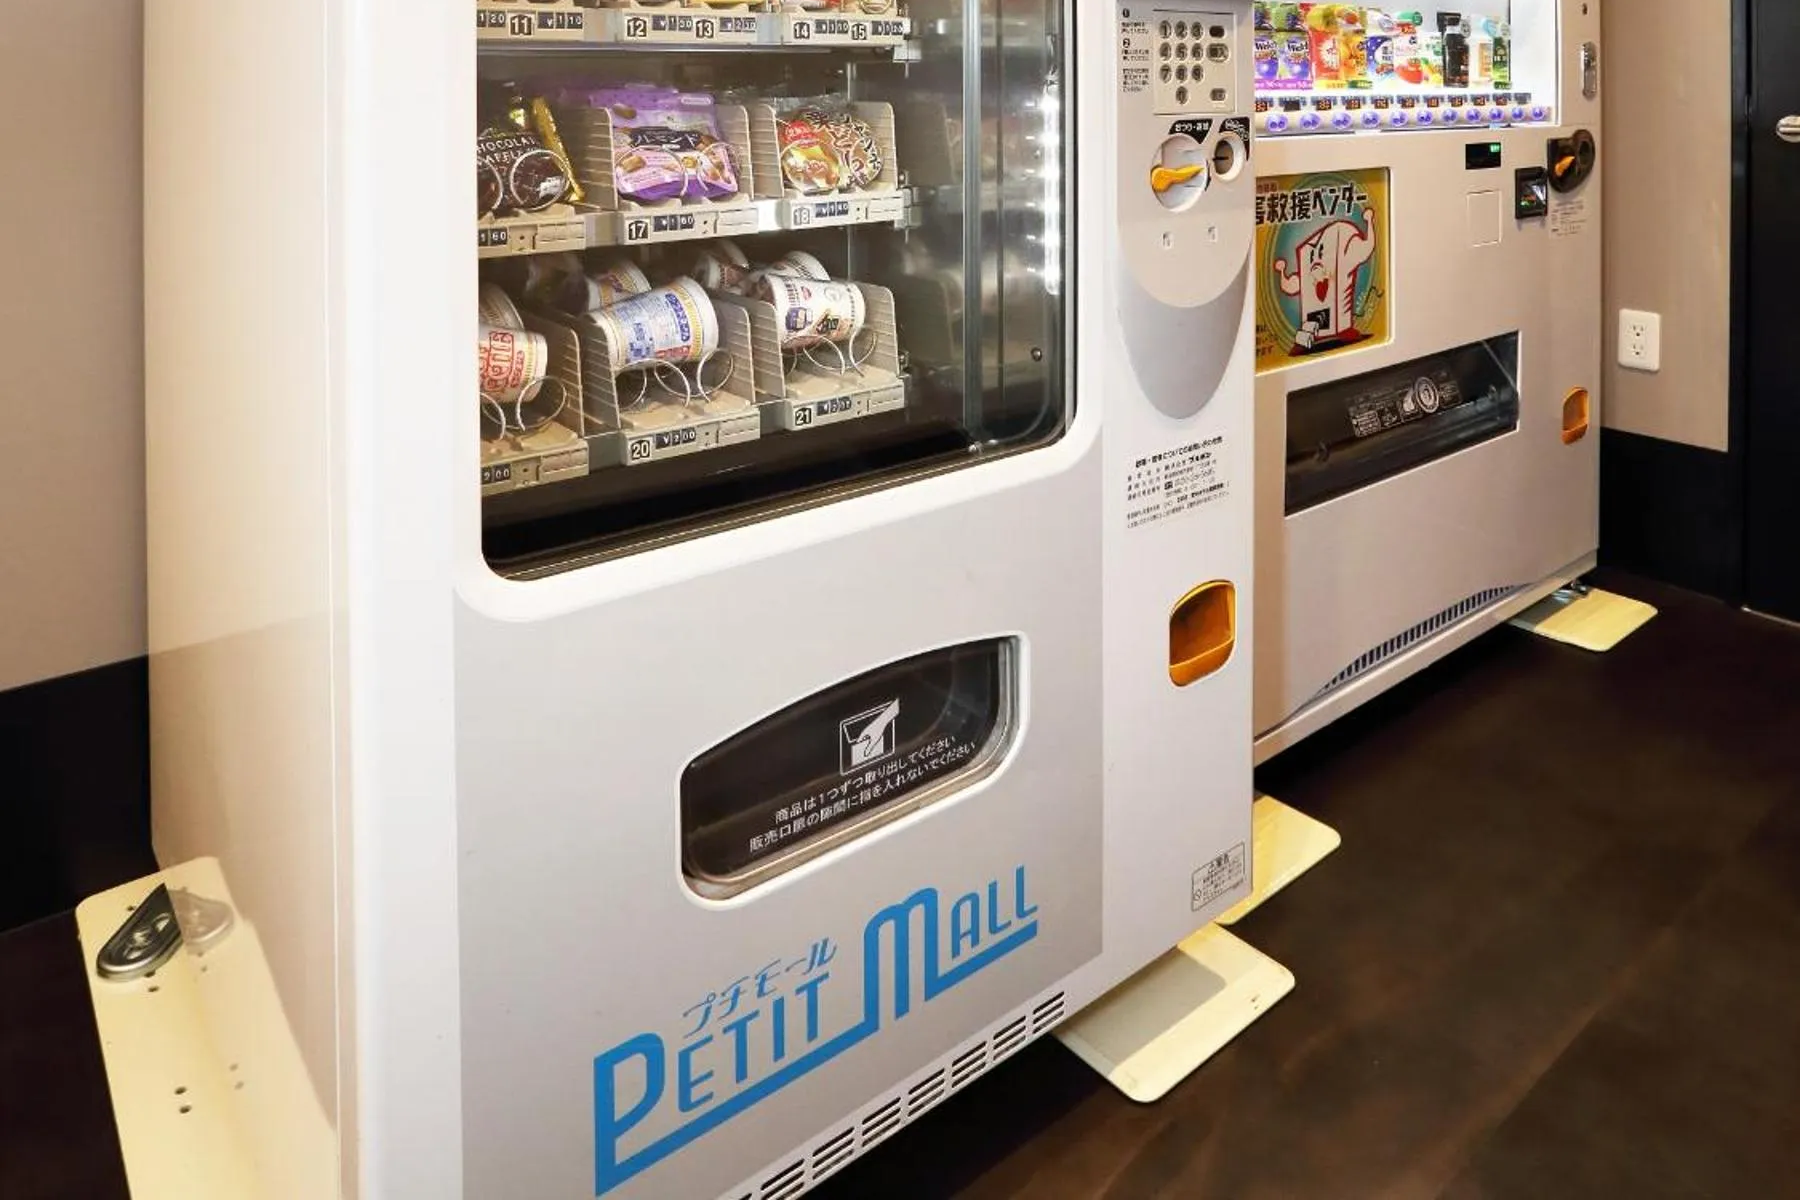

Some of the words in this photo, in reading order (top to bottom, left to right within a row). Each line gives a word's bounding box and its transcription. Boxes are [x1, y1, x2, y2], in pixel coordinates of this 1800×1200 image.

[512, 20, 531, 35] 11
[629, 20, 647, 36] 12
[698, 22, 714, 37] 13
[794, 23, 810, 38] 14
[852, 23, 866, 39] 15
[795, 208, 810, 224] 18
[629, 222, 647, 239] 17
[796, 409, 811, 425] 21
[632, 442, 649, 459] 20
[863, 864, 1039, 1020] MALL
[683, 936, 838, 1040] プチモール
